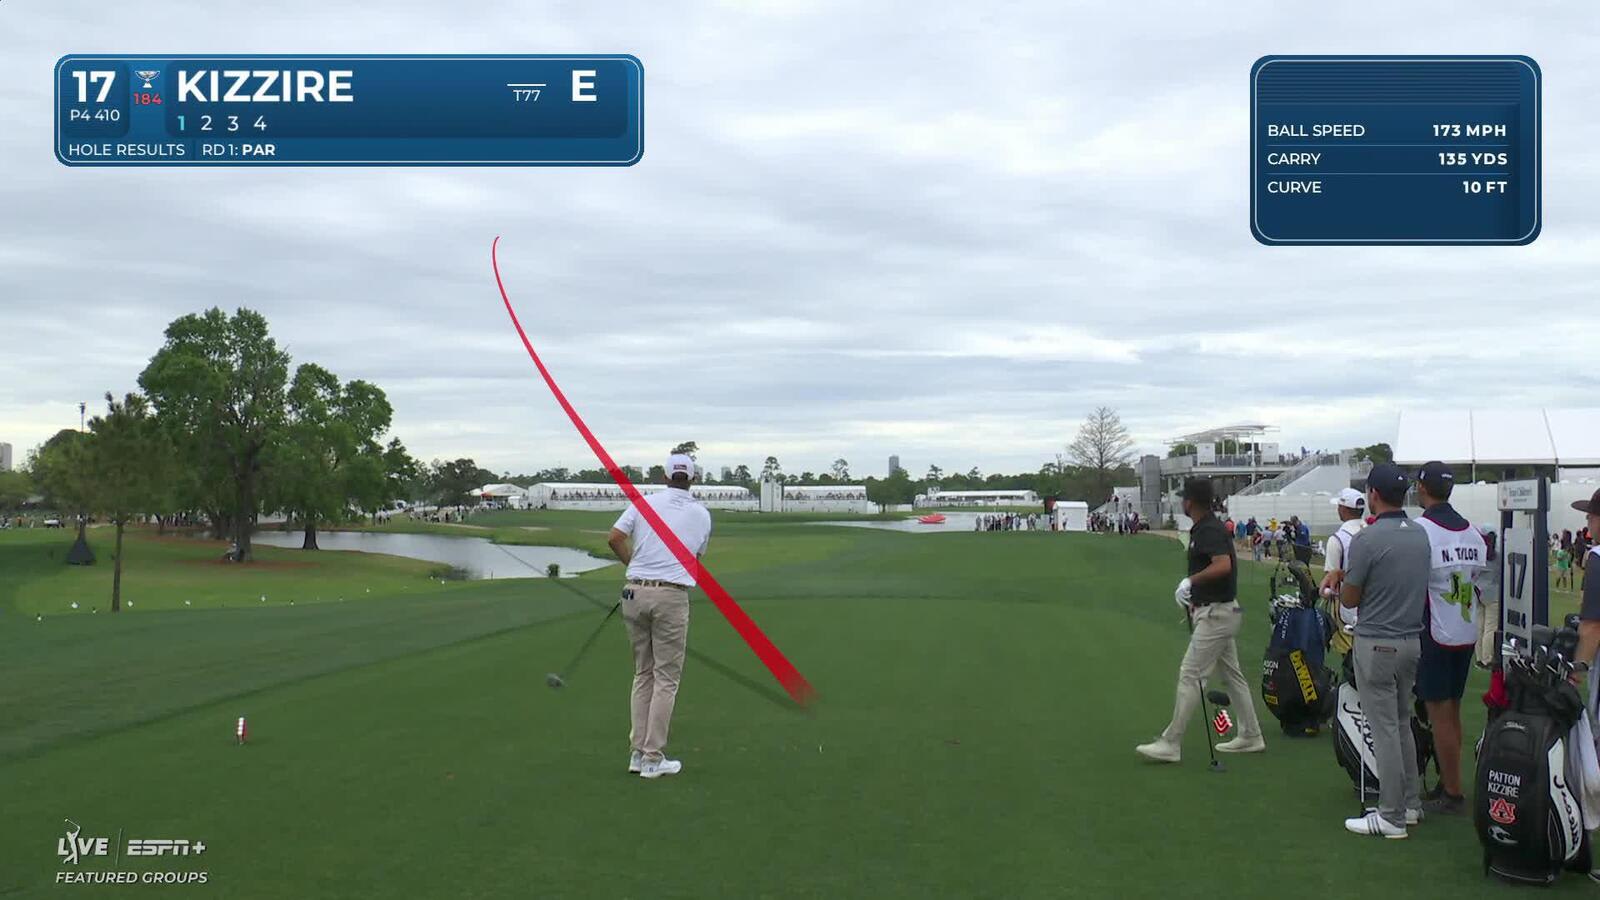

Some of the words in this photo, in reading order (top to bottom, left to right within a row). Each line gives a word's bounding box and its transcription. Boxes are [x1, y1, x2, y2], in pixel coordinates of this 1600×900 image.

[1442, 549, 1454, 563] N.
[1508, 552, 1527, 599] 17
[1489, 769, 1521, 787] PATTON
[1487, 782, 1520, 798] KIZZIRE
